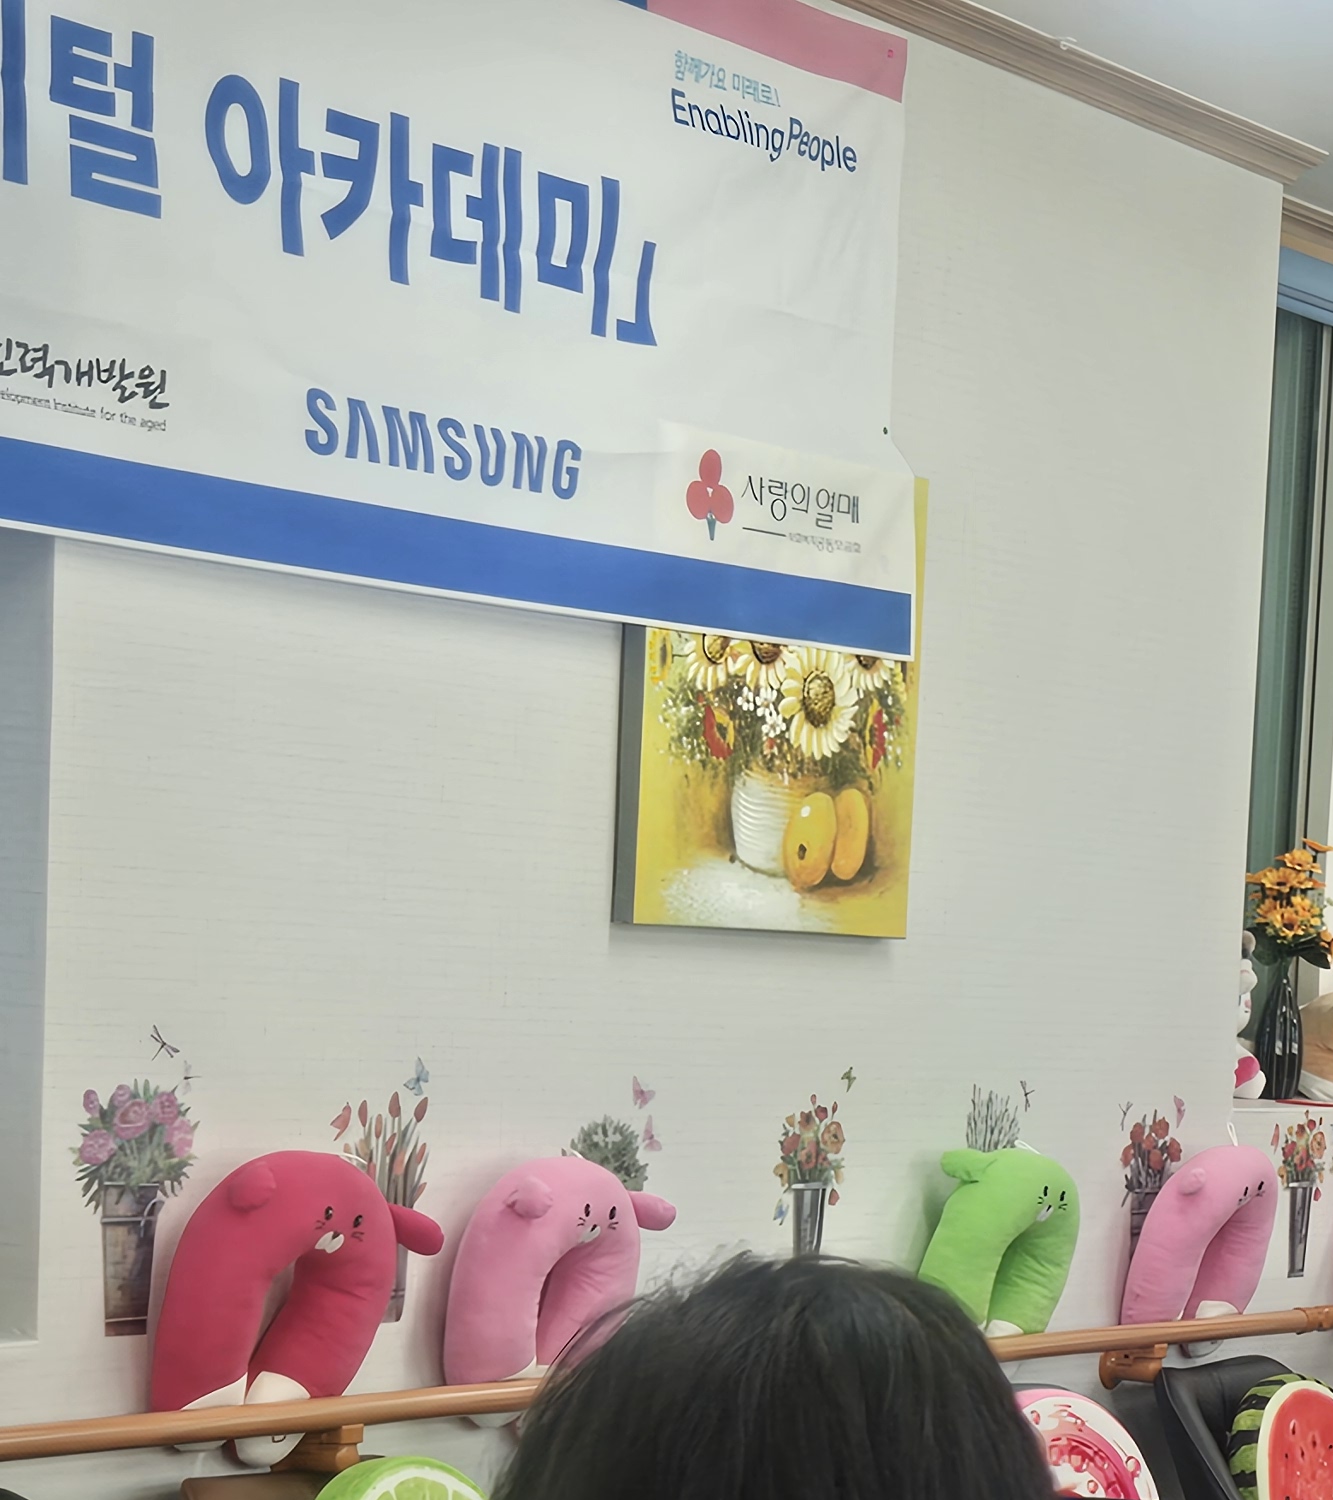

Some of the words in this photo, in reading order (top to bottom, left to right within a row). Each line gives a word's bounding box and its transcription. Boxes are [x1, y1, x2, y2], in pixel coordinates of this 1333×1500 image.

[671, 88, 785, 162] Enabling
[786, 117, 858, 173] People
[304, 387, 582, 500] SAMSUNG
